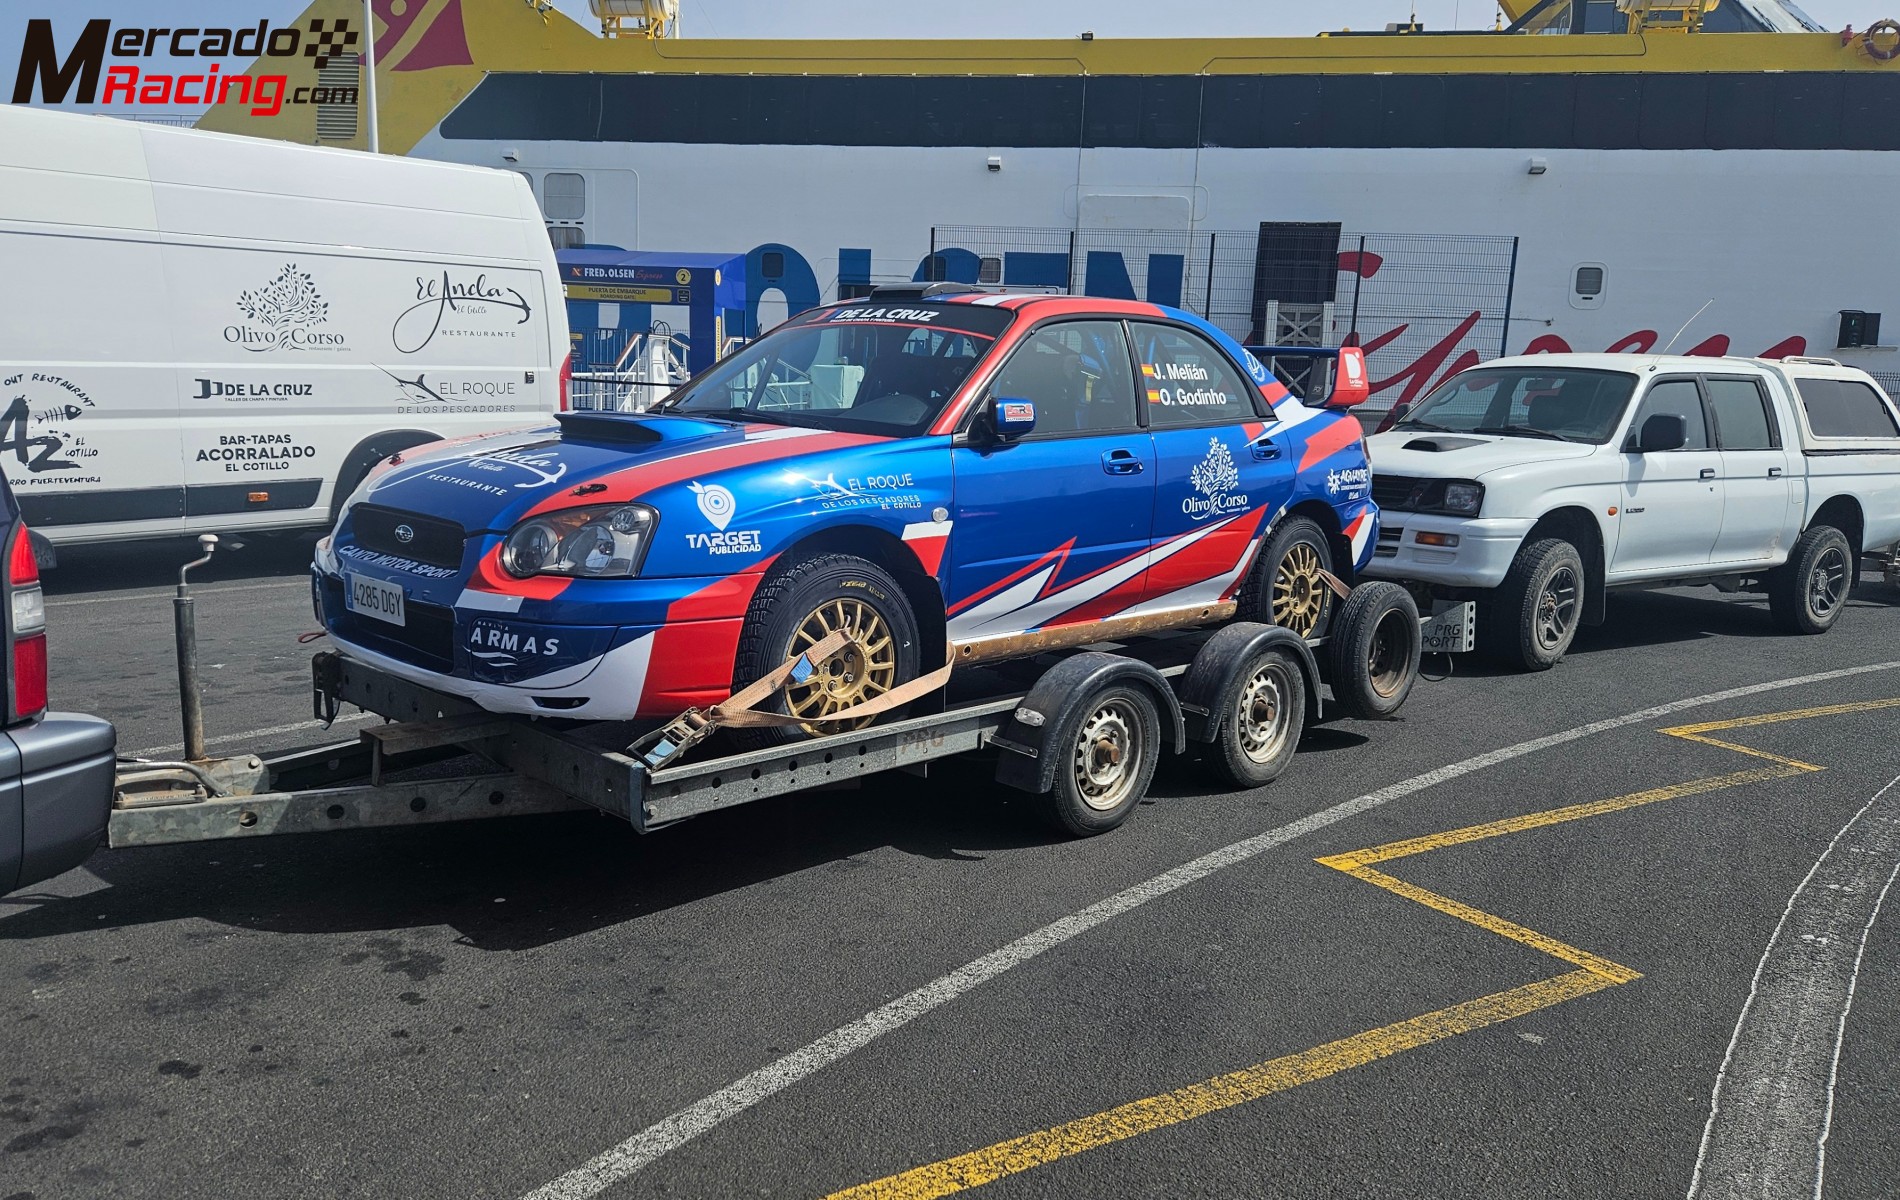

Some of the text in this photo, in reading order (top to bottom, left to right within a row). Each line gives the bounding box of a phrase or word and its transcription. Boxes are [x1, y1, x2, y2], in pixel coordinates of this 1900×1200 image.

[680, 273, 686, 281] 2
[835, 308, 864, 319] DE
[860, 308, 886, 319] LA
[885, 308, 940, 322] CRUZ
[223, 325, 345, 345] Olivo Corso
[441, 329, 517, 338] RESTAURANTE
[1153, 363, 1208, 380] J. Melián
[4, 373, 96, 408] OUT RESTAURANT
[225, 384, 246, 396] DE
[250, 384, 270, 396] LA
[273, 384, 313, 396] CRUZ
[439, 382, 516, 397] EL ROQUE
[1160, 388, 1227, 406] O. Godinho
[397, 405, 516, 414] DE LOS PESCADORES
[75, 437, 86, 446] EL
[219, 434, 292, 446] BAR-TAPAS
[65, 448, 99, 457] COTILLO
[196, 445, 316, 461] ACORRALADO
[225, 461, 290, 472] EL COTILLO
[30, 476, 101, 486] FUERTEVENTURA
[427, 474, 508, 496] RESTAURANTE
[848, 473, 914, 491] EL ROQUE
[821, 495, 920, 509] DE LOS PESCADORES
[1182, 496, 1210, 514] Olivo
[1217, 493, 1248, 509] Corso
[685, 530, 761, 549] TARGET
[709, 543, 762, 555] PUBLICIDAD
[339, 545, 459, 578] CANTO MOTOR SPORT
[353, 582, 401, 617] 4285 DGY
[1434, 624, 1461, 636] PRG
[470, 627, 560, 656] ARMAS
